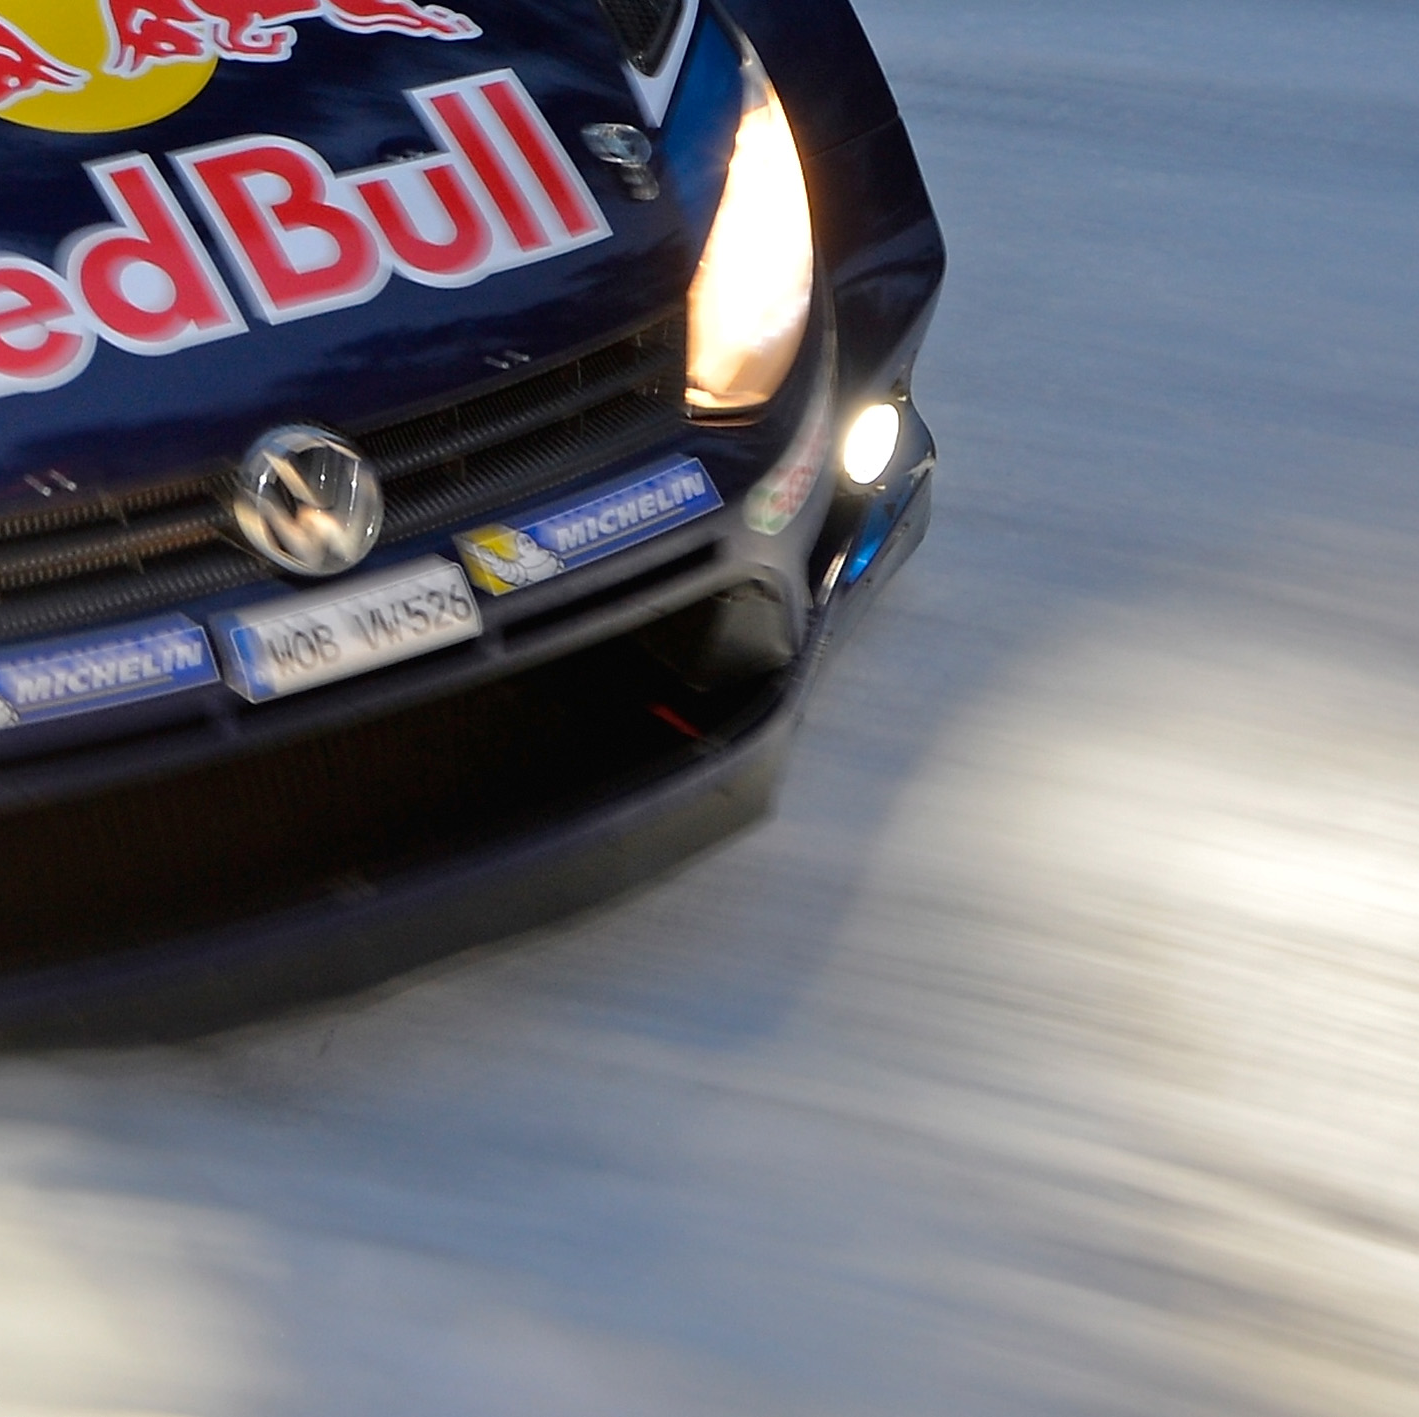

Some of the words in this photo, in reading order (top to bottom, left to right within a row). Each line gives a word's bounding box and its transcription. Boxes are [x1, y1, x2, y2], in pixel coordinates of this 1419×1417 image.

[185, 79, 605, 311] Bull
[556, 471, 707, 553] MICHELIN
[14, 640, 203, 705] MICHELIN
